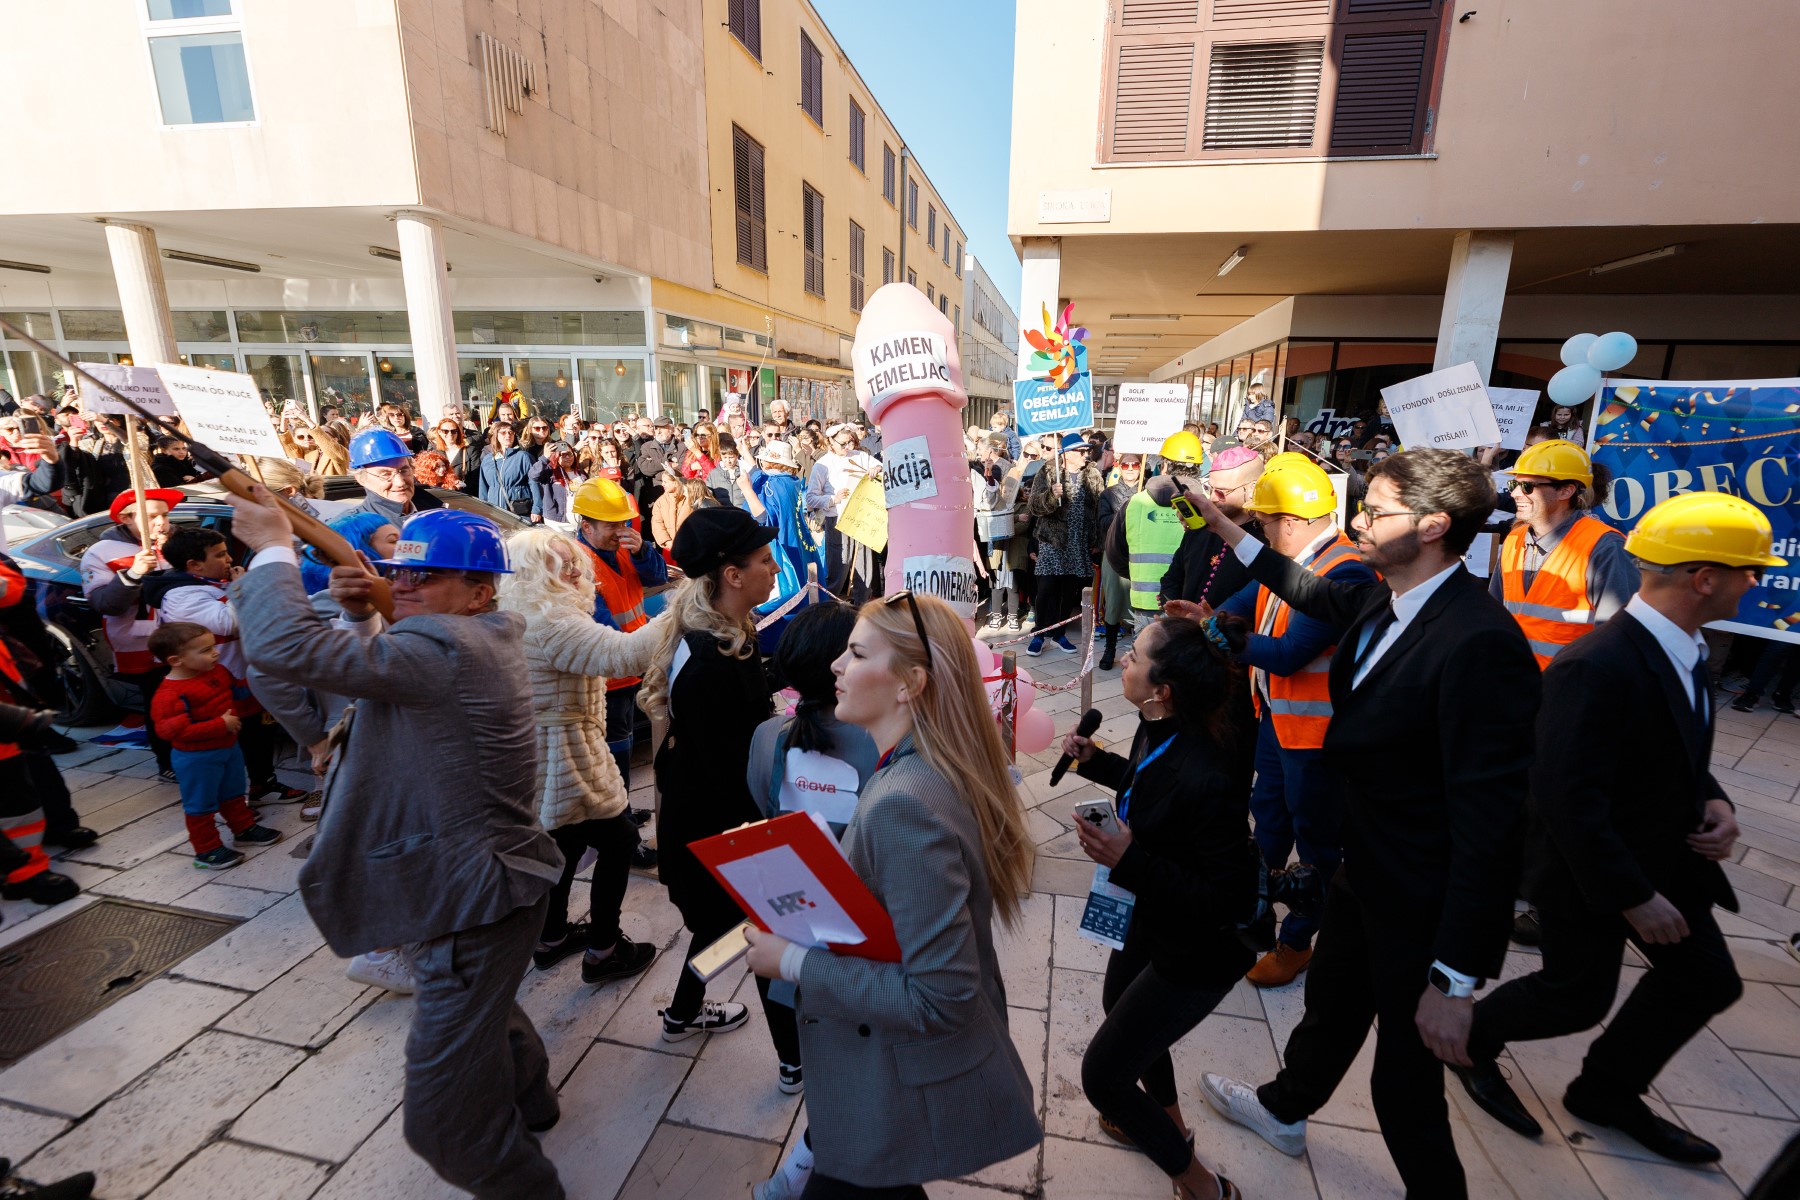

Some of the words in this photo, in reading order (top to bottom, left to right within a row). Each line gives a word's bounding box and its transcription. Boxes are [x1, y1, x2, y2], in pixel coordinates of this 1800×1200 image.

[870, 336, 933, 367] KAMEN
[173, 382, 208, 393] RADIM
[209, 387, 225, 395] OD
[867, 362, 949, 397] TEMELJAC
[142, 386, 161, 394] NIJE
[1437, 387, 1457, 399] DOŠLI
[1456, 382, 1482, 394] ZEMLJA
[148, 397, 161, 405] KN
[1022, 391, 1086, 410] OBEĆANA
[1390, 406, 1401, 415] EU
[1401, 396, 1436, 412] FONDOVI
[1031, 405, 1080, 423] ZEMLJA
[233, 426, 247, 434] MI
[248, 428, 259, 436] JE
[259, 429, 268, 437] U
[1433, 429, 1469, 443] OTIŠLA!!!
[1602, 445, 1800, 521] OBEĆ
[795, 776, 837, 794] nova
